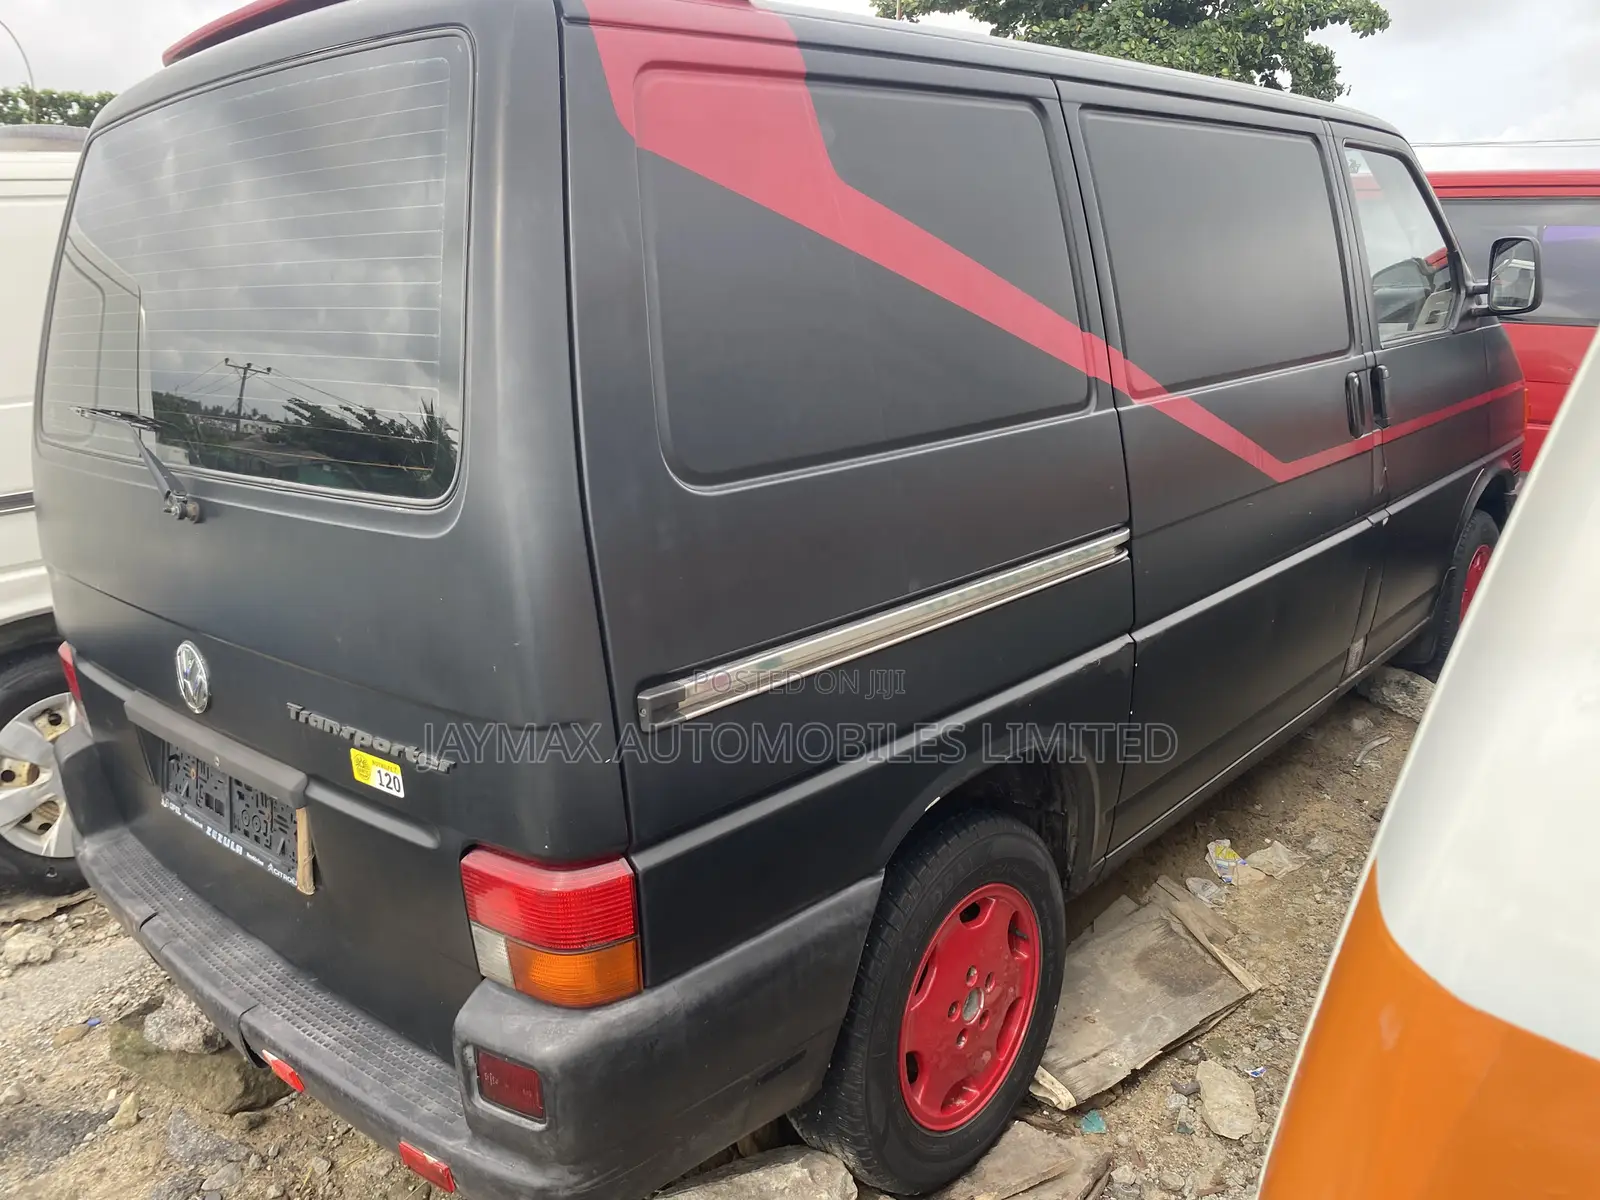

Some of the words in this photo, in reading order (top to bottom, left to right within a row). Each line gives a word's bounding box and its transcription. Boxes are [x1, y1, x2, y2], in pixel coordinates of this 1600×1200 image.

[287, 702, 457, 774] Transporter
[376, 769, 401, 793] 120
[273, 868, 298, 886] CITROË
